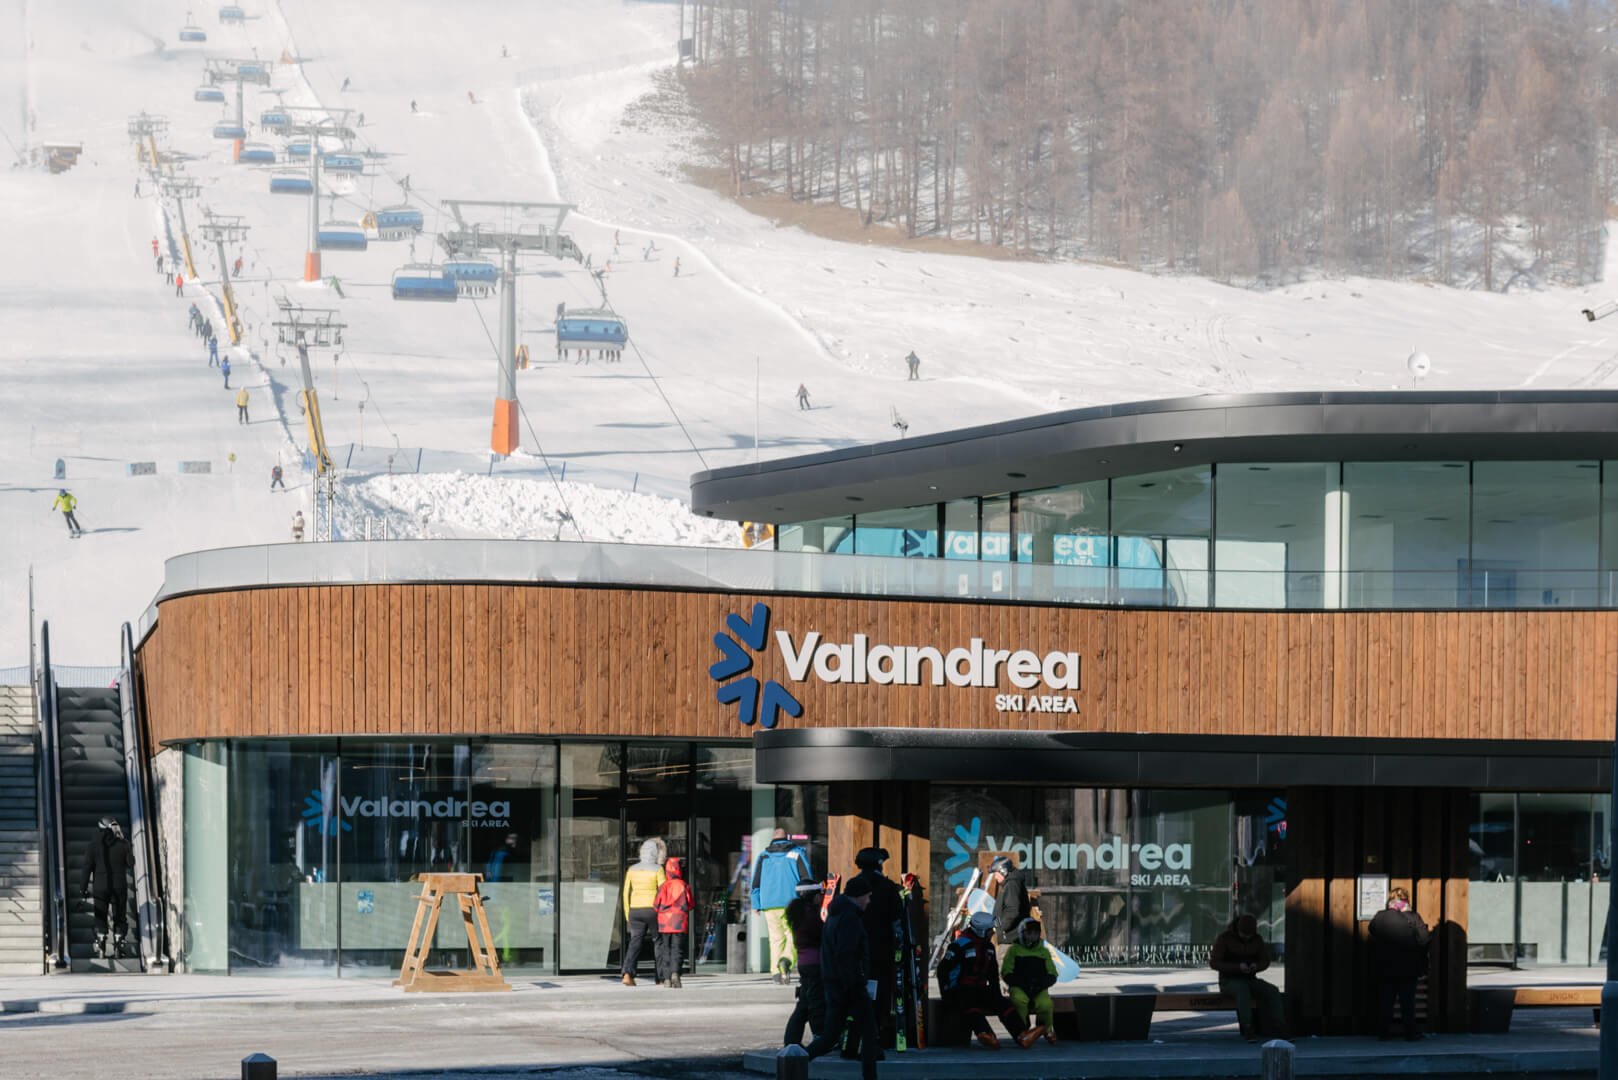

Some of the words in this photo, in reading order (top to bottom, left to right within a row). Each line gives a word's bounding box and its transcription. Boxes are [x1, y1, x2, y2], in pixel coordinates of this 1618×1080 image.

[934, 529, 1094, 556] Valanea
[775, 630, 1080, 690] Valandrea
[995, 693, 1023, 711] SKI
[1026, 694, 1079, 713] AREA
[340, 796, 511, 818] Valandrea
[480, 819, 511, 828] AREA
[985, 835, 1192, 870] Valandrea
[1131, 873, 1151, 886] SKI
[1153, 873, 1191, 886] AREA
